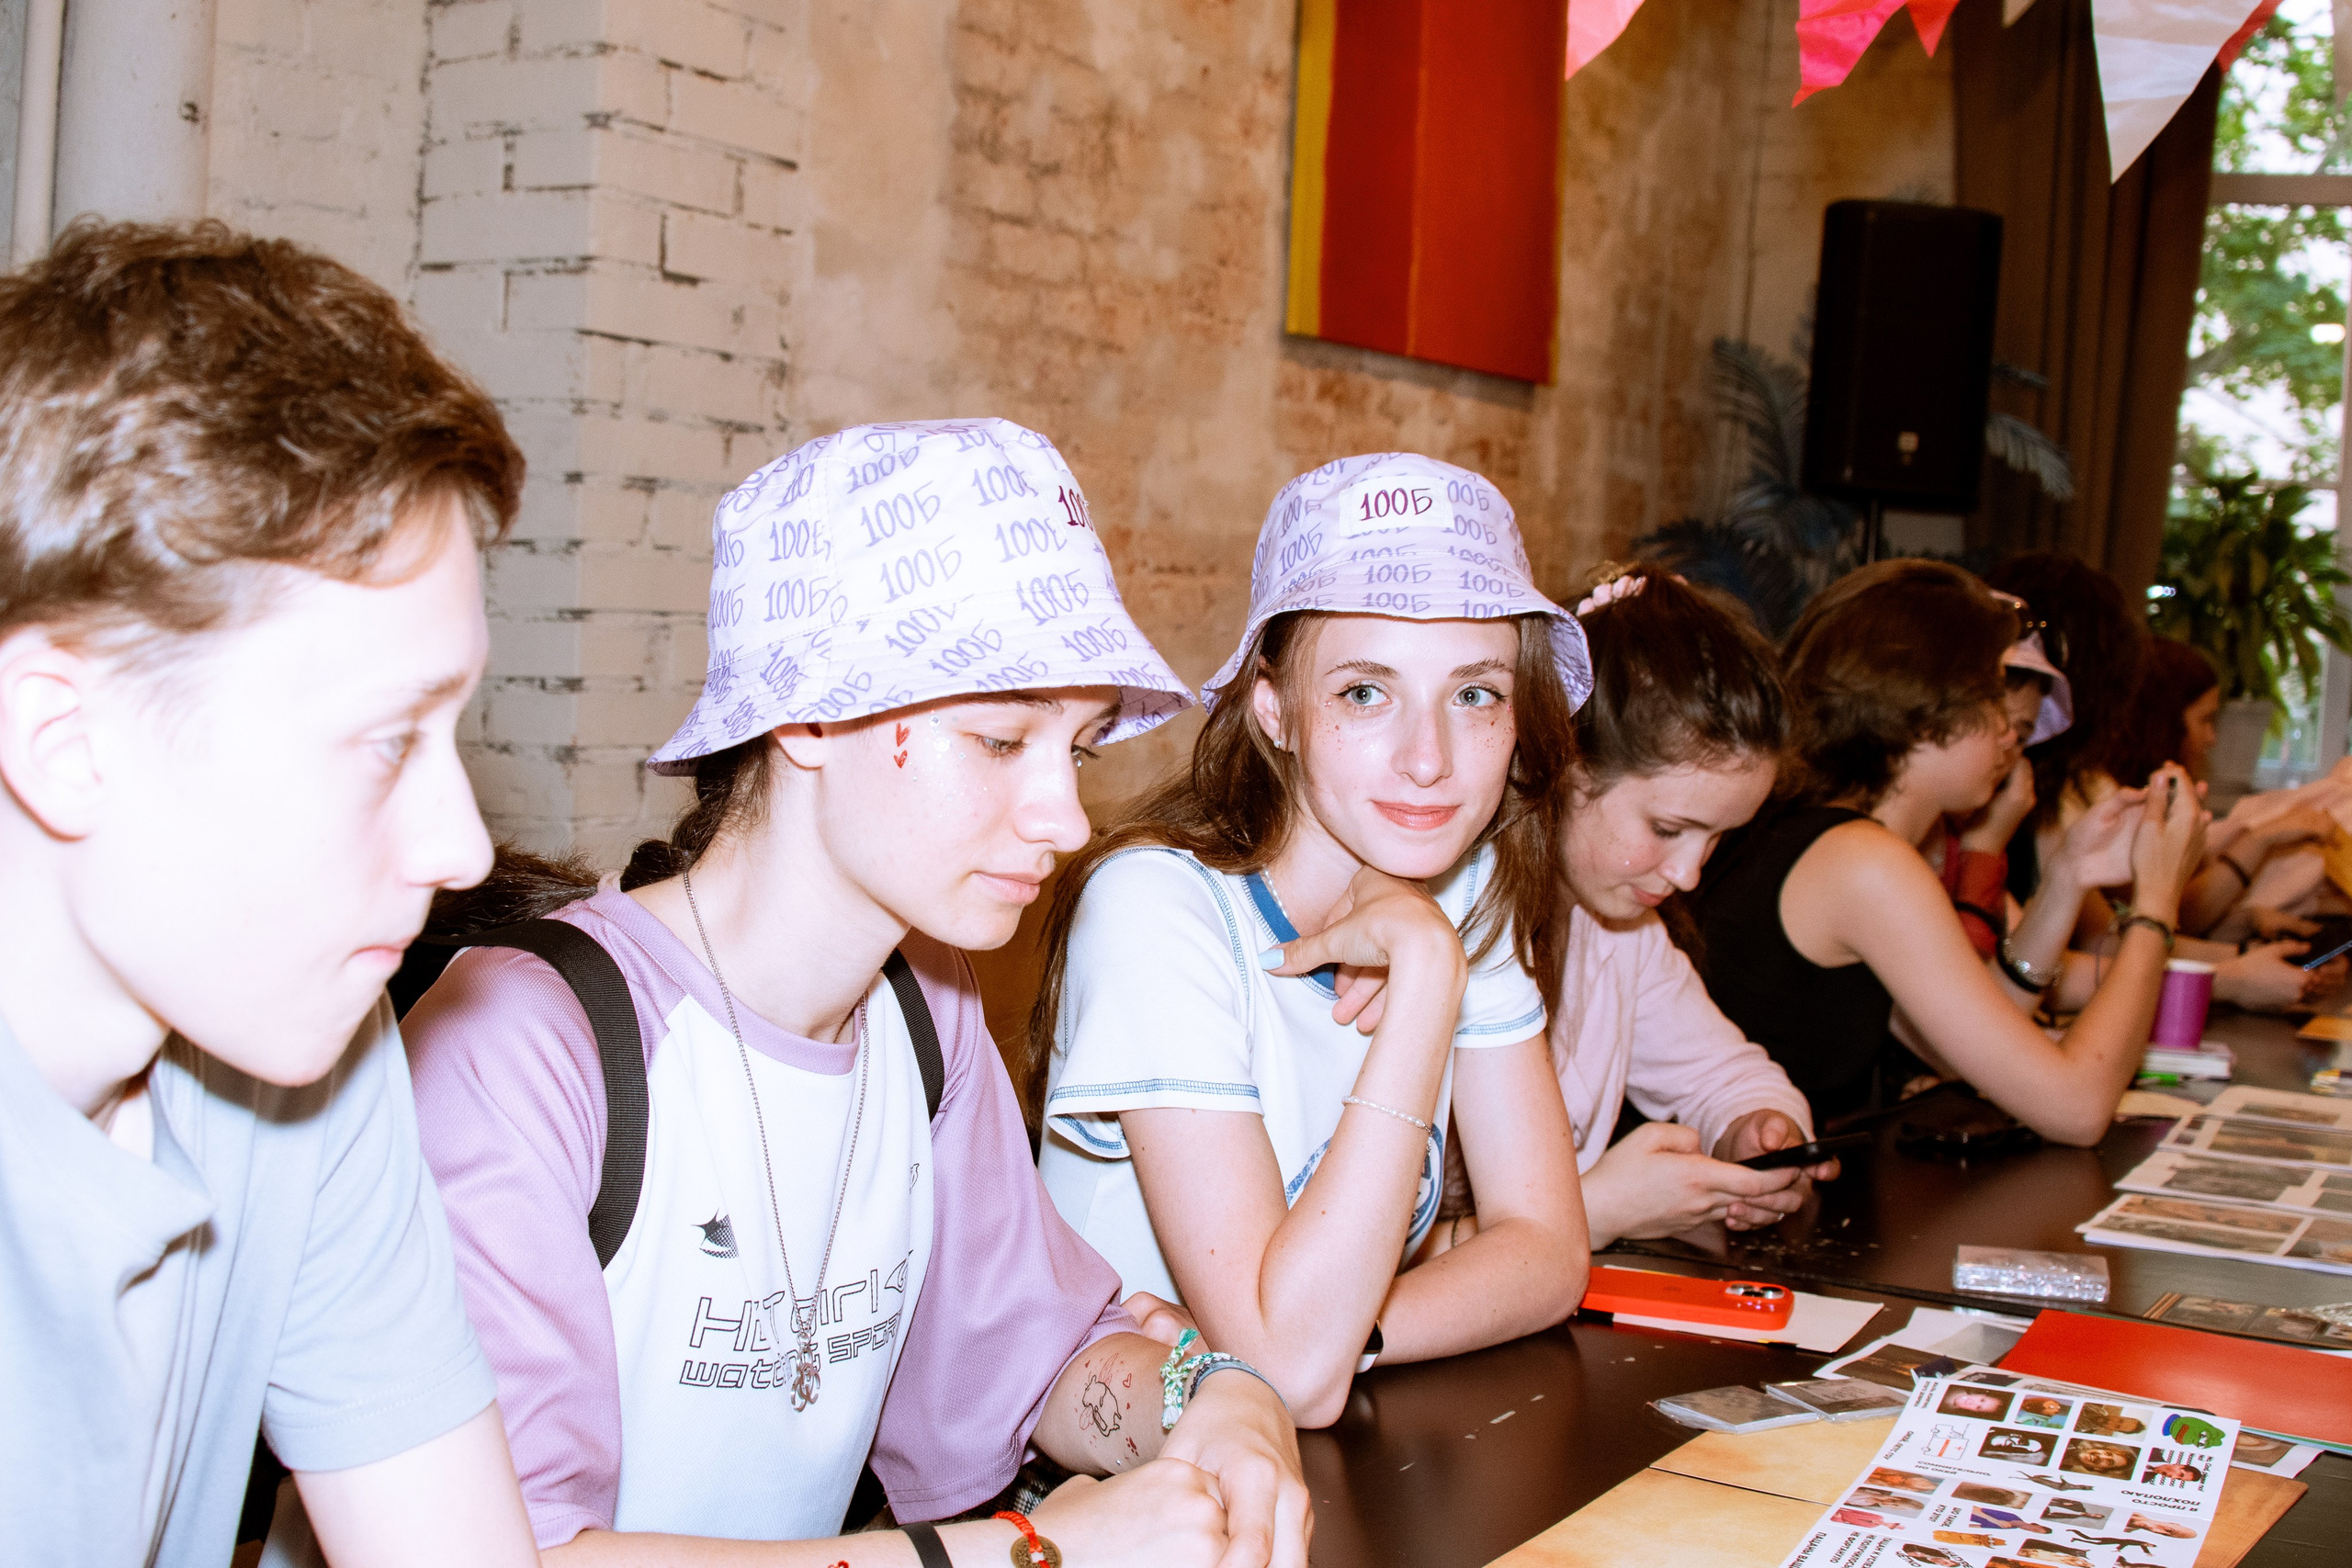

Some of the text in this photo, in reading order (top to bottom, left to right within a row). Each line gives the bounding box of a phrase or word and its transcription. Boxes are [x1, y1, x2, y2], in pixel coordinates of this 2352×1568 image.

[1359, 487, 1433, 522] 100Б
[1447, 479, 1490, 512] 00Б
[859, 480, 941, 548] 100Б
[1441, 514, 1498, 546] 00Б
[1279, 521, 1323, 577] 100Б
[879, 534, 963, 604] 100Б
[1364, 563, 1432, 585] 100Б
[1457, 570, 1526, 598] 100Б
[763, 576, 829, 623] 100Б
[1015, 568, 1091, 626] 100Б
[1360, 592, 1432, 614] 100Б
[928, 617, 1003, 679] 100Б
[1059, 616, 1128, 663] 100Б
[2120, 1490, 2200, 1506] ПОХЛОПАЮ
[2132, 1499, 2186, 1510] ПРОСТО
[1801, 1531, 1827, 1555] ПАЦАНЫ
